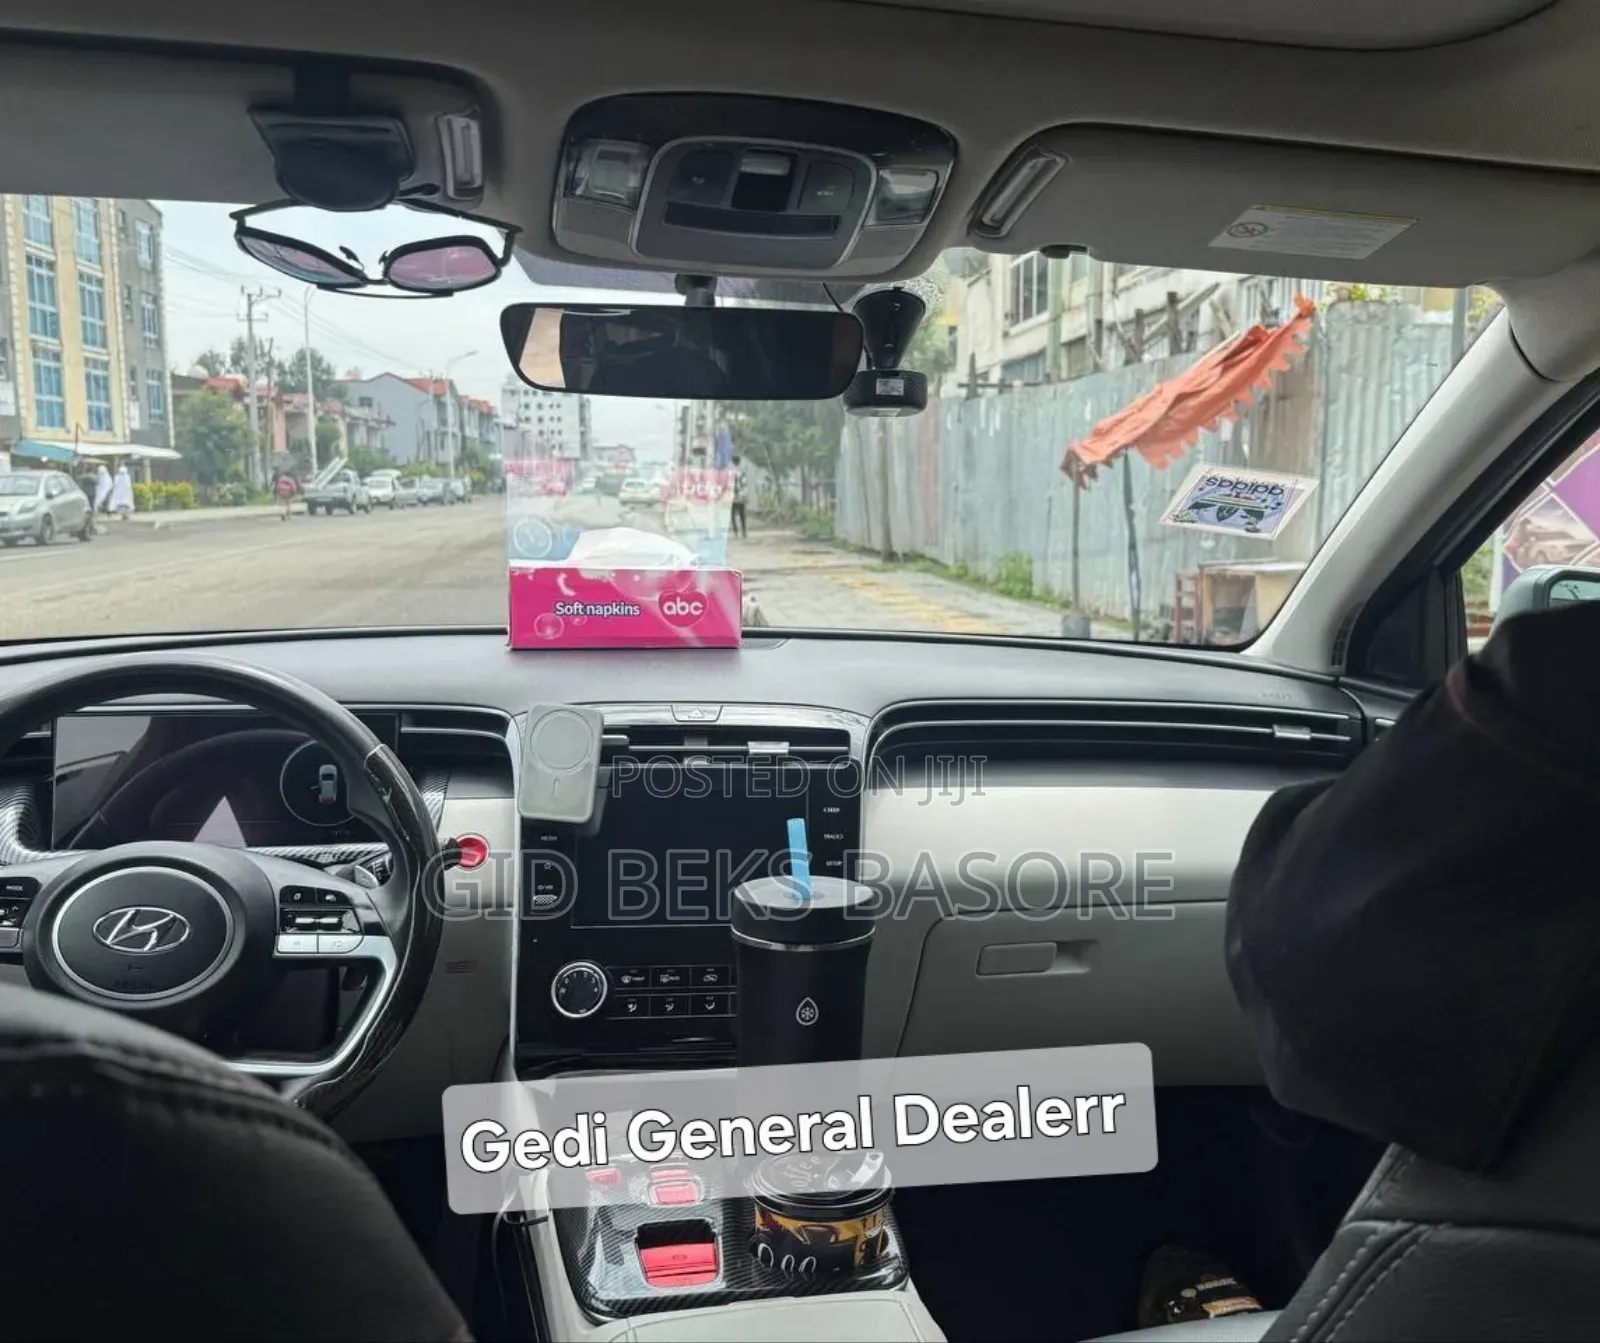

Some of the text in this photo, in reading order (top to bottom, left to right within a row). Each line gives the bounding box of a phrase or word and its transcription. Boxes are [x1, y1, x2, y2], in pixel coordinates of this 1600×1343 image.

[1205, 477, 1285, 496] adidas
[555, 601, 640, 618] Soft napkins
[662, 596, 704, 616] abc
